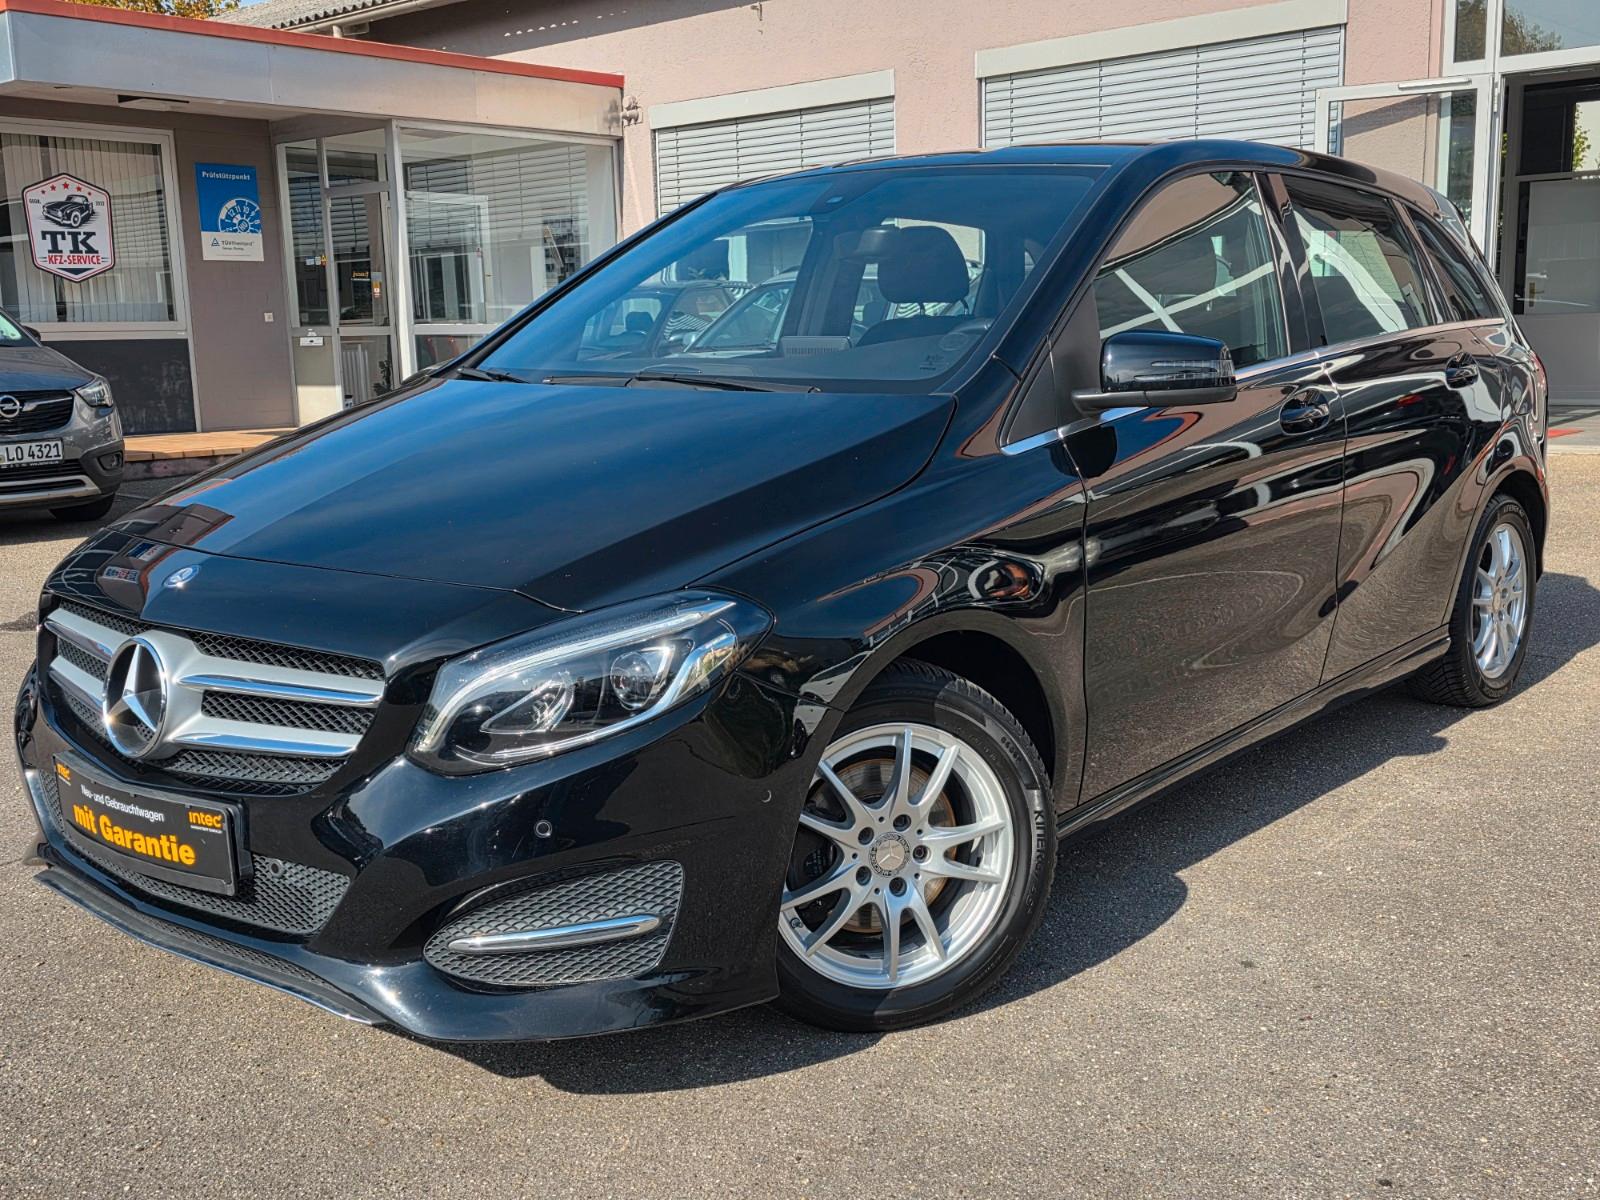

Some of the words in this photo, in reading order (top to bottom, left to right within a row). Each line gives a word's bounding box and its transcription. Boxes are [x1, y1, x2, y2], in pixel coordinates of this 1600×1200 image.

[41, 231, 99, 254] TK
[48, 255, 101, 265] KFZ-SERVICE
[5, 445, 24, 461] LO
[28, 442, 61, 460] 4321
[105, 795, 165, 822] Gebrauchtwagen
[188, 811, 222, 828] intec
[73, 804, 97, 834] mit
[99, 814, 196, 865] Garantie
